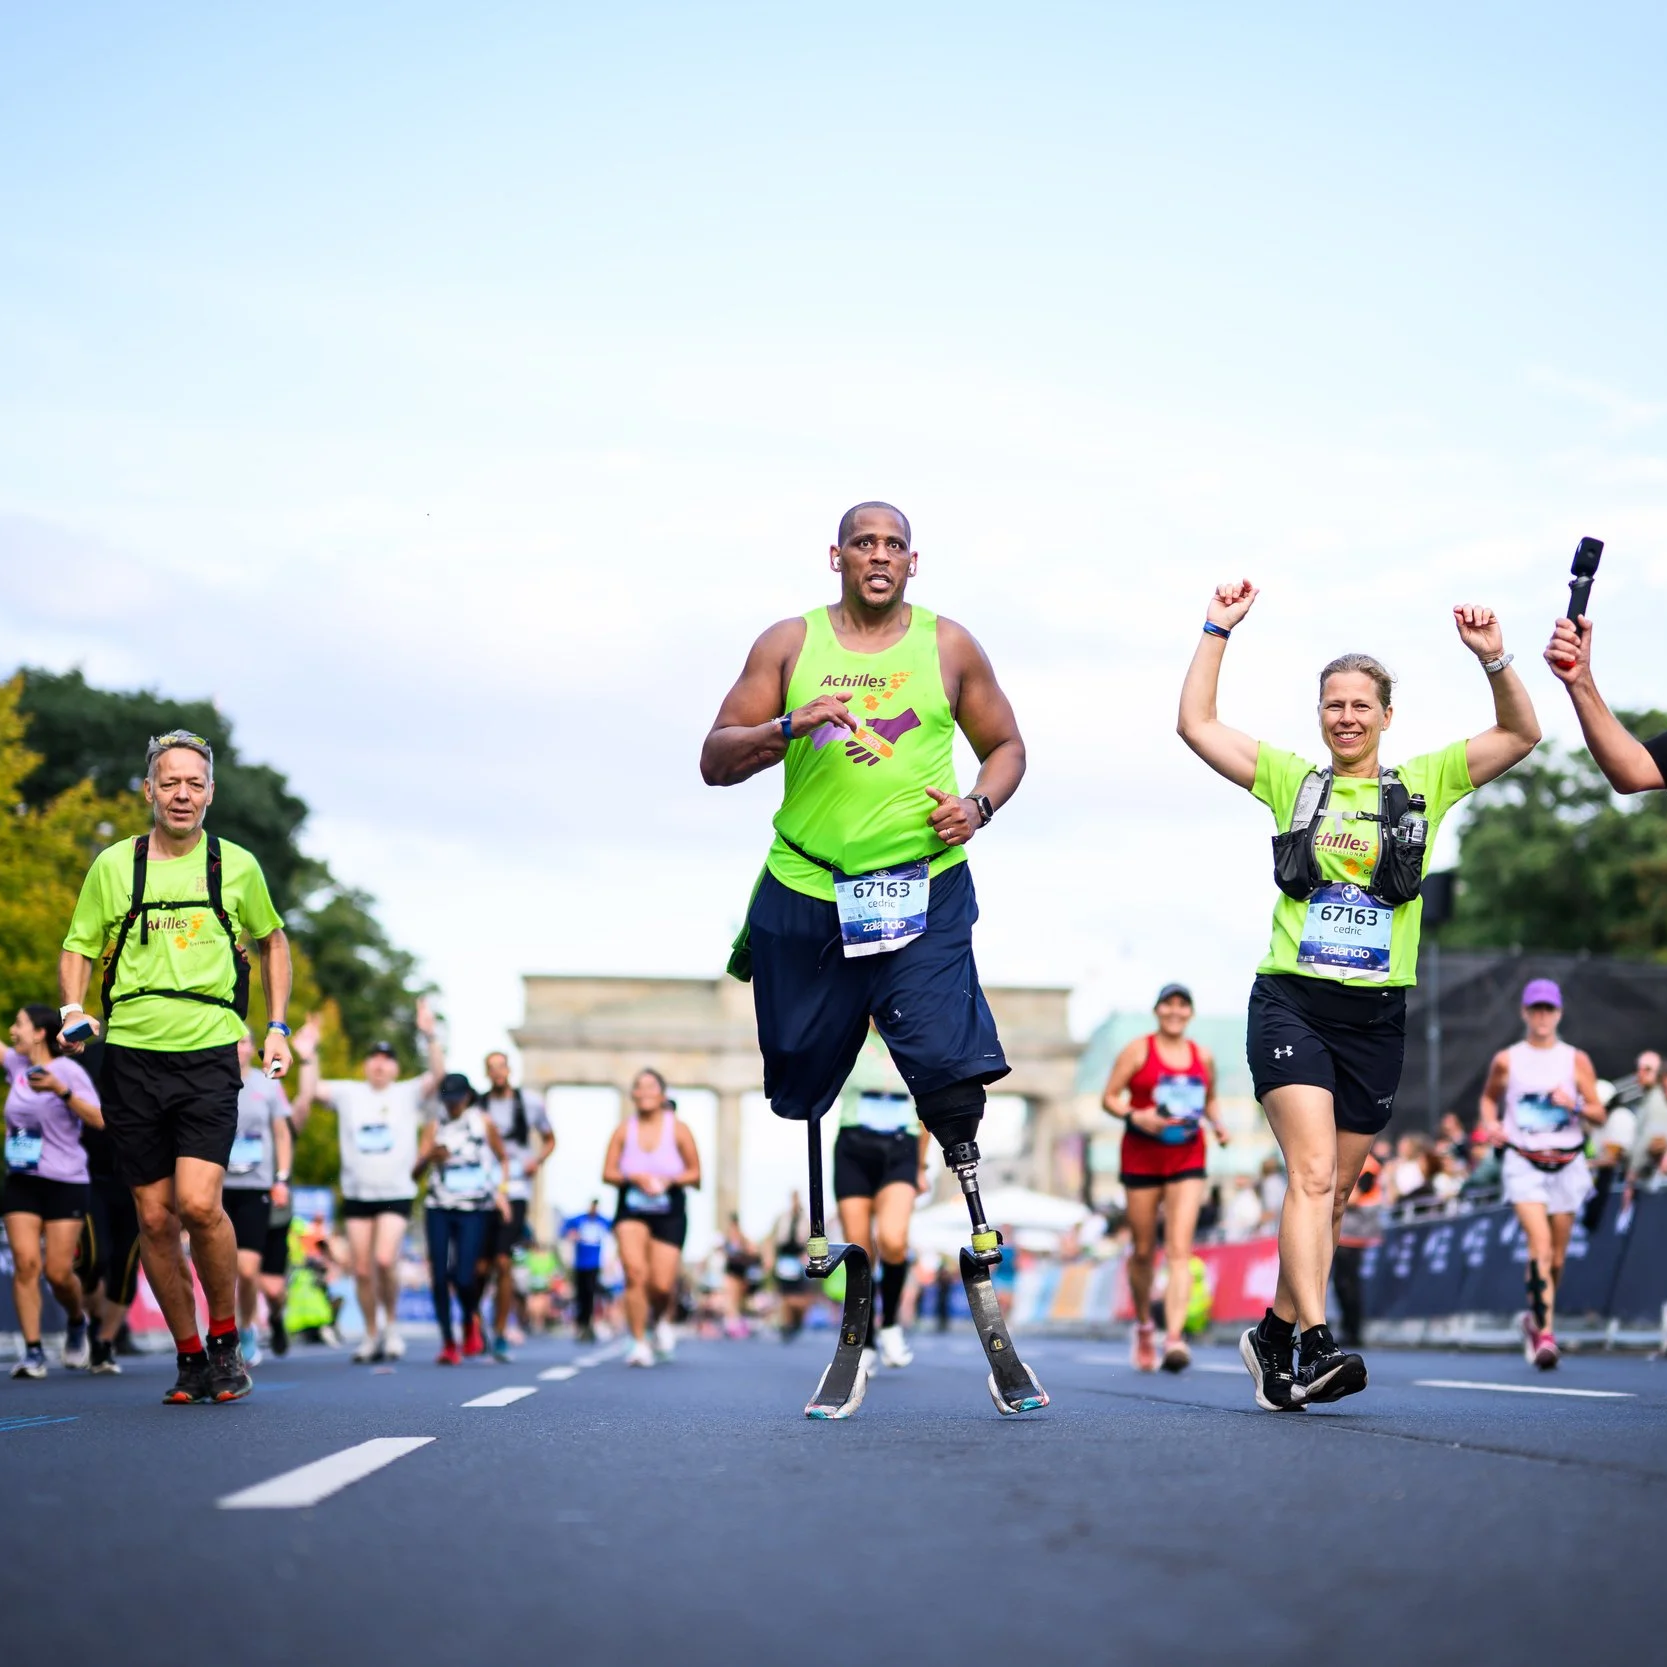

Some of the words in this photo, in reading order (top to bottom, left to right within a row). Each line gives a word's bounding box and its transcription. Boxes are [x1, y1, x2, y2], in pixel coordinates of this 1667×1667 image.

[820, 673, 887, 688] Achilles
[1314, 832, 1370, 852] chilles
[1315, 847, 1367, 858] NTERNATIONAL
[853, 881, 910, 899] 67163
[868, 899, 896, 908] cedric
[1321, 905, 1378, 926] 67163
[1385, 912, 1391, 920] D
[862, 919, 906, 932] zalando
[1333, 925, 1363, 936] cedric
[1320, 945, 1370, 959] zalando
